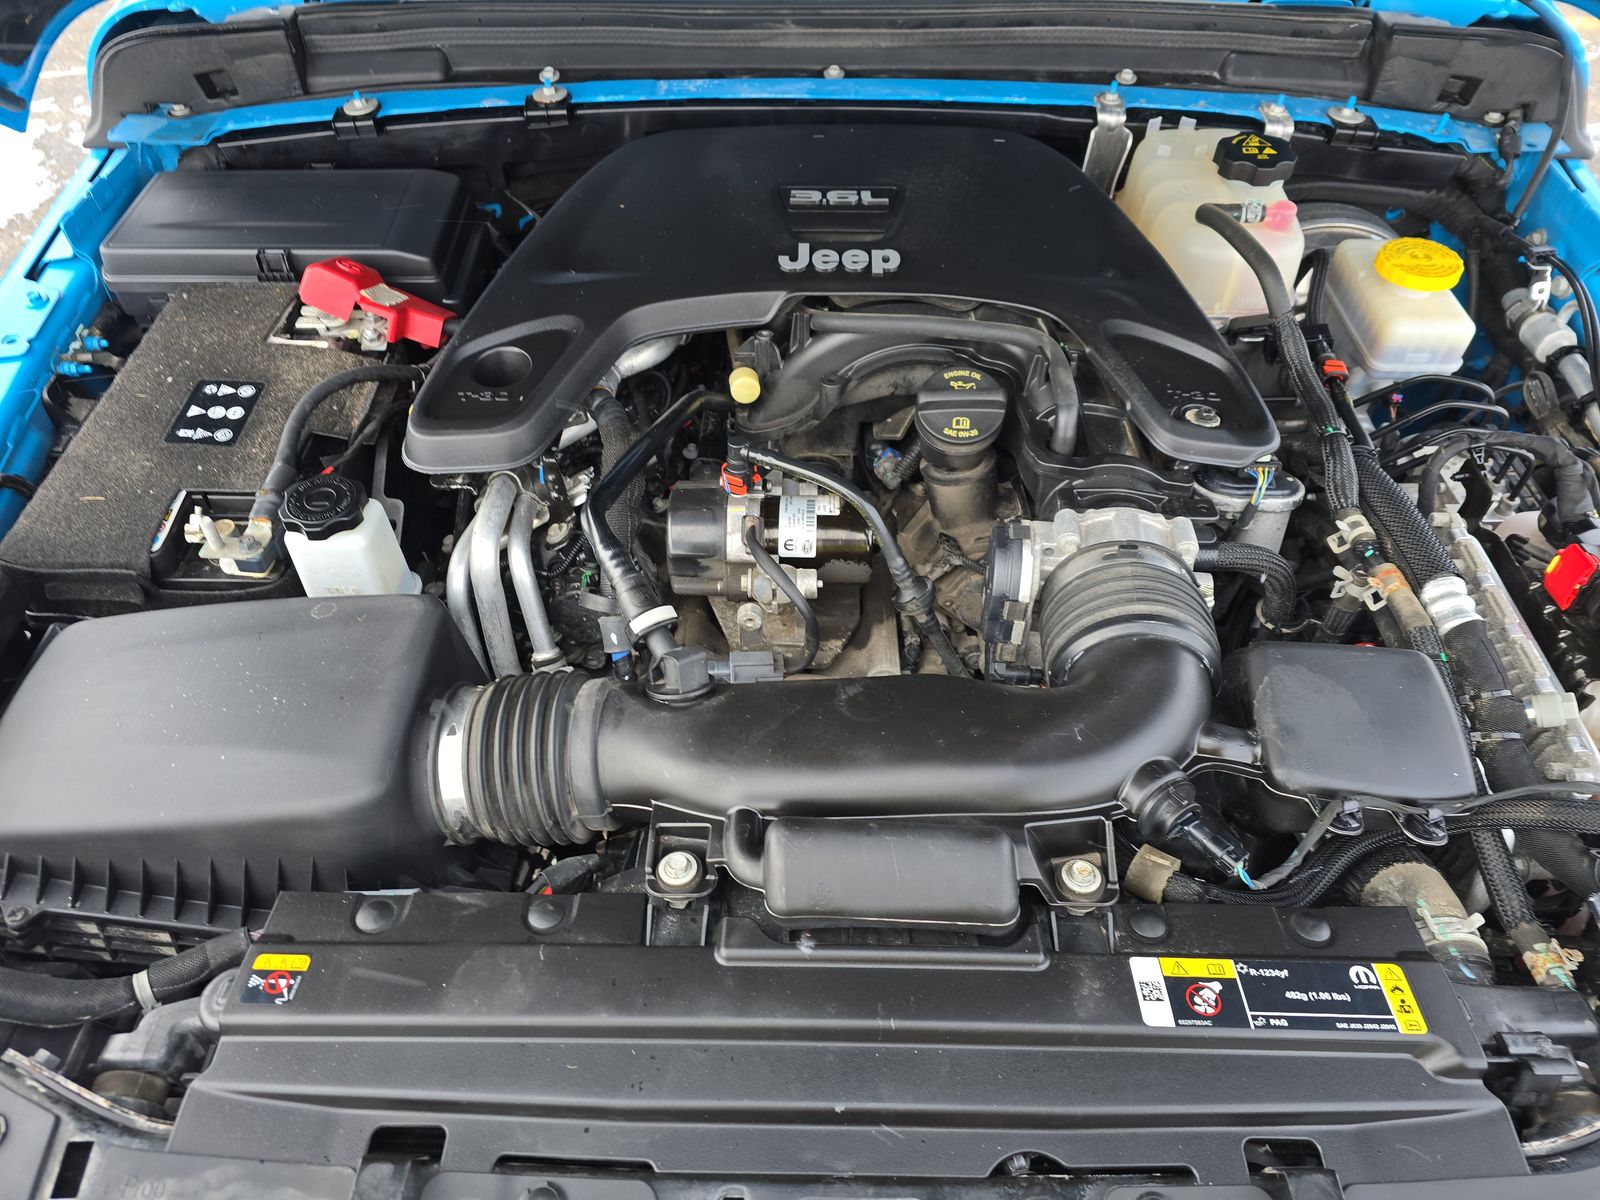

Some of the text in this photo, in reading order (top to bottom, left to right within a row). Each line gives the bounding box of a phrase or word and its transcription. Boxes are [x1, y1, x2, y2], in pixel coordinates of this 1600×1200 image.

[789, 189, 890, 206] 3.6L
[777, 242, 901, 277] Jeep
[943, 370, 982, 381] ENGINE OIL
[942, 427, 957, 438] SAE
[1249, 967, 1290, 979] R-1234yf
[1284, 990, 1309, 1001] 482g
[1333, 990, 1352, 1003] lbs)
[1268, 1018, 1289, 1027] PAG
